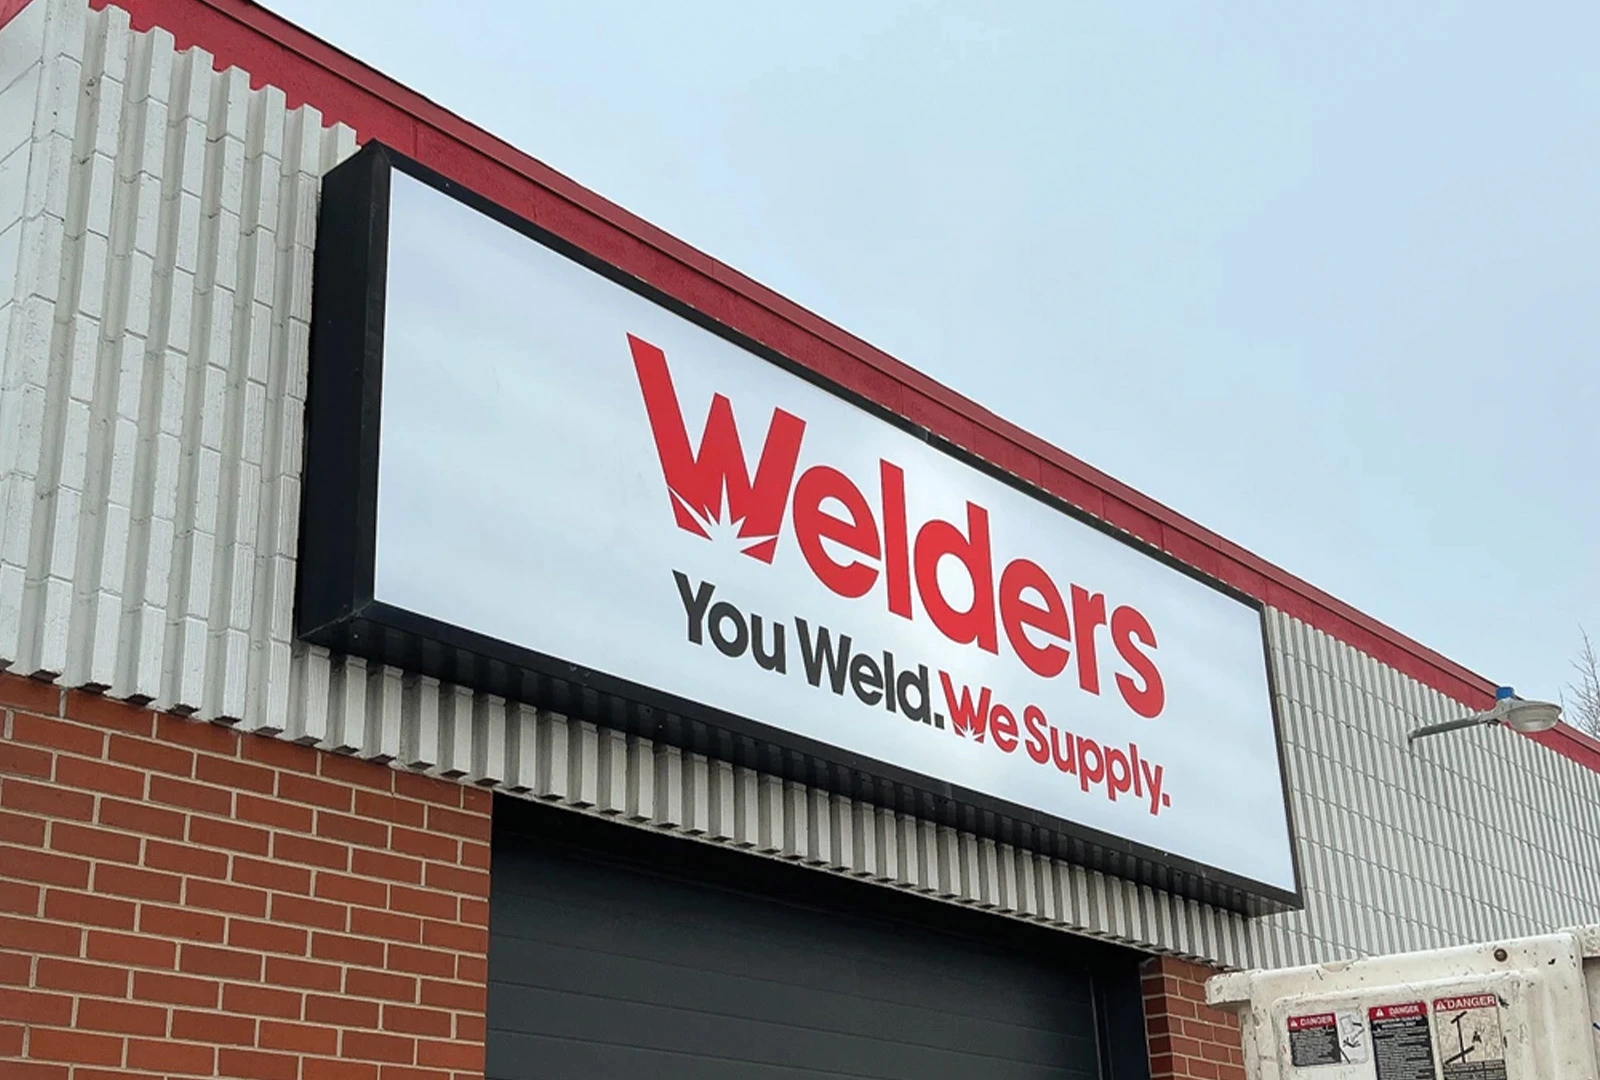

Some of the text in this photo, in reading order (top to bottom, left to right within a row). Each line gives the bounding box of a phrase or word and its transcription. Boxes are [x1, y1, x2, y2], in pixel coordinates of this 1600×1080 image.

[627, 334, 1164, 718] Welders
[672, 569, 1170, 815] You Weld. We Supply.
[1389, 1004, 1420, 1016] DANGER
[1447, 995, 1495, 1010] DANGER
[1300, 1015, 1333, 1027] DANGER
